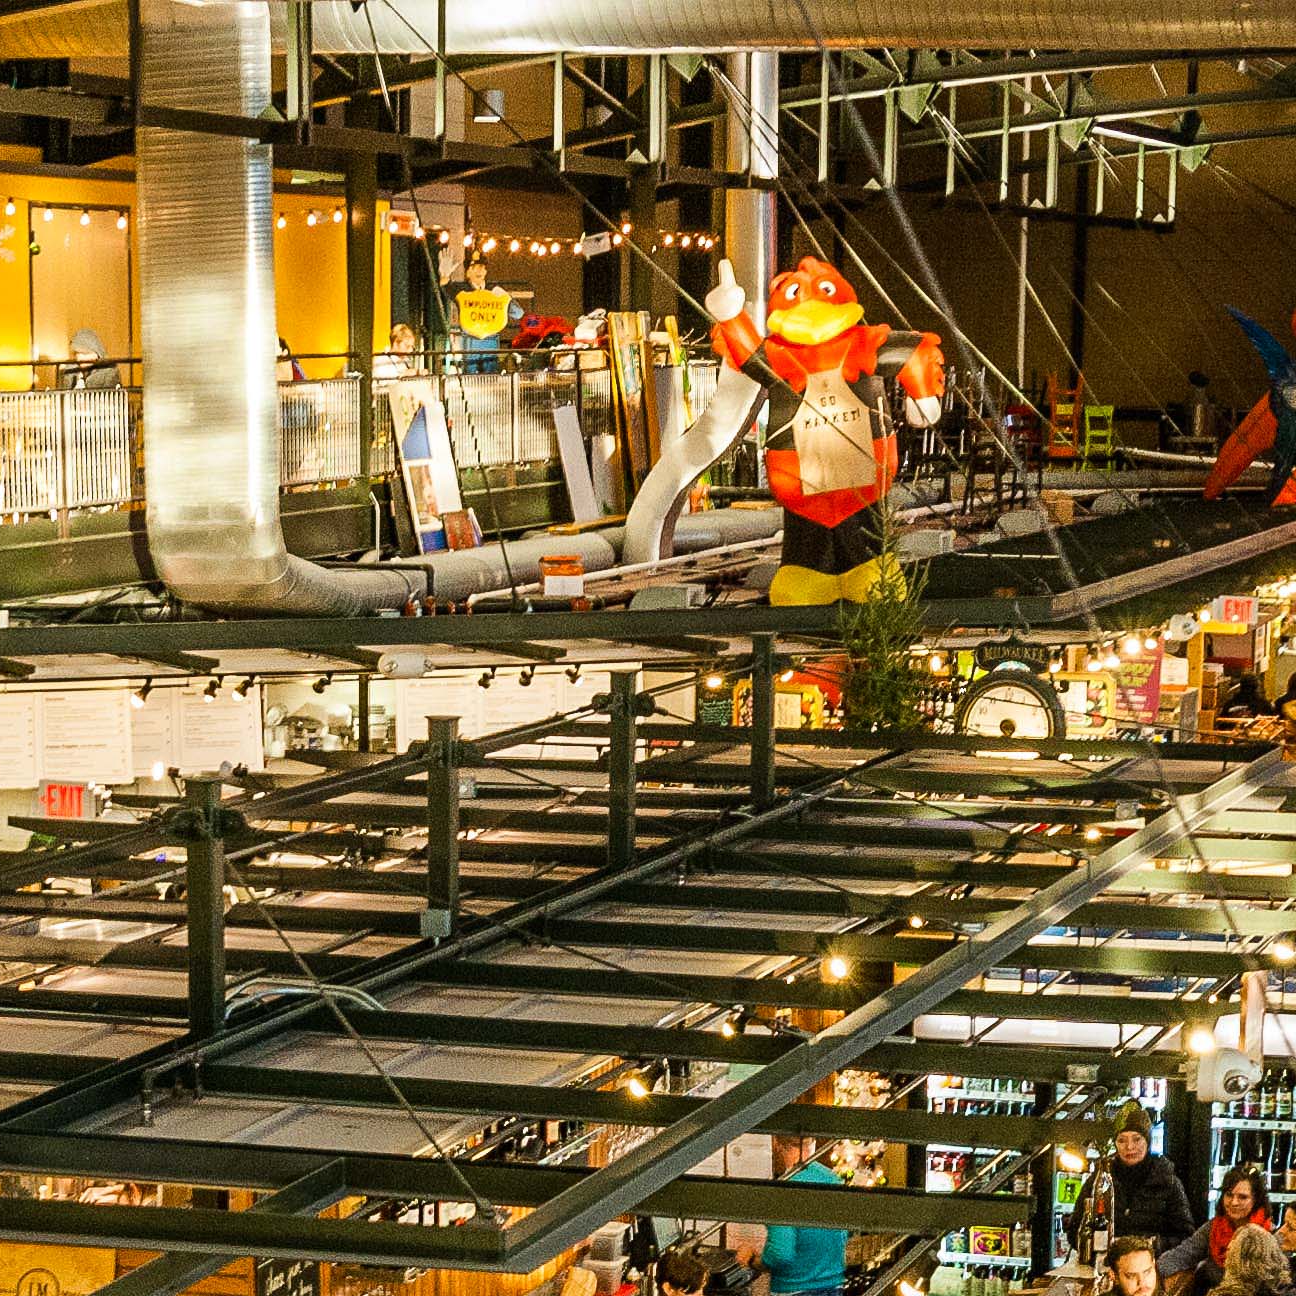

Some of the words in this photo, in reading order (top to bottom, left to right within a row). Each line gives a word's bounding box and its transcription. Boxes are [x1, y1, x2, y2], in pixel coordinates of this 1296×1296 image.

[470, 311, 497, 322] ONLY
[820, 395, 836, 407] GO
[1223, 599, 1254, 623] EXIT
[46, 784, 84, 818] EXIT
